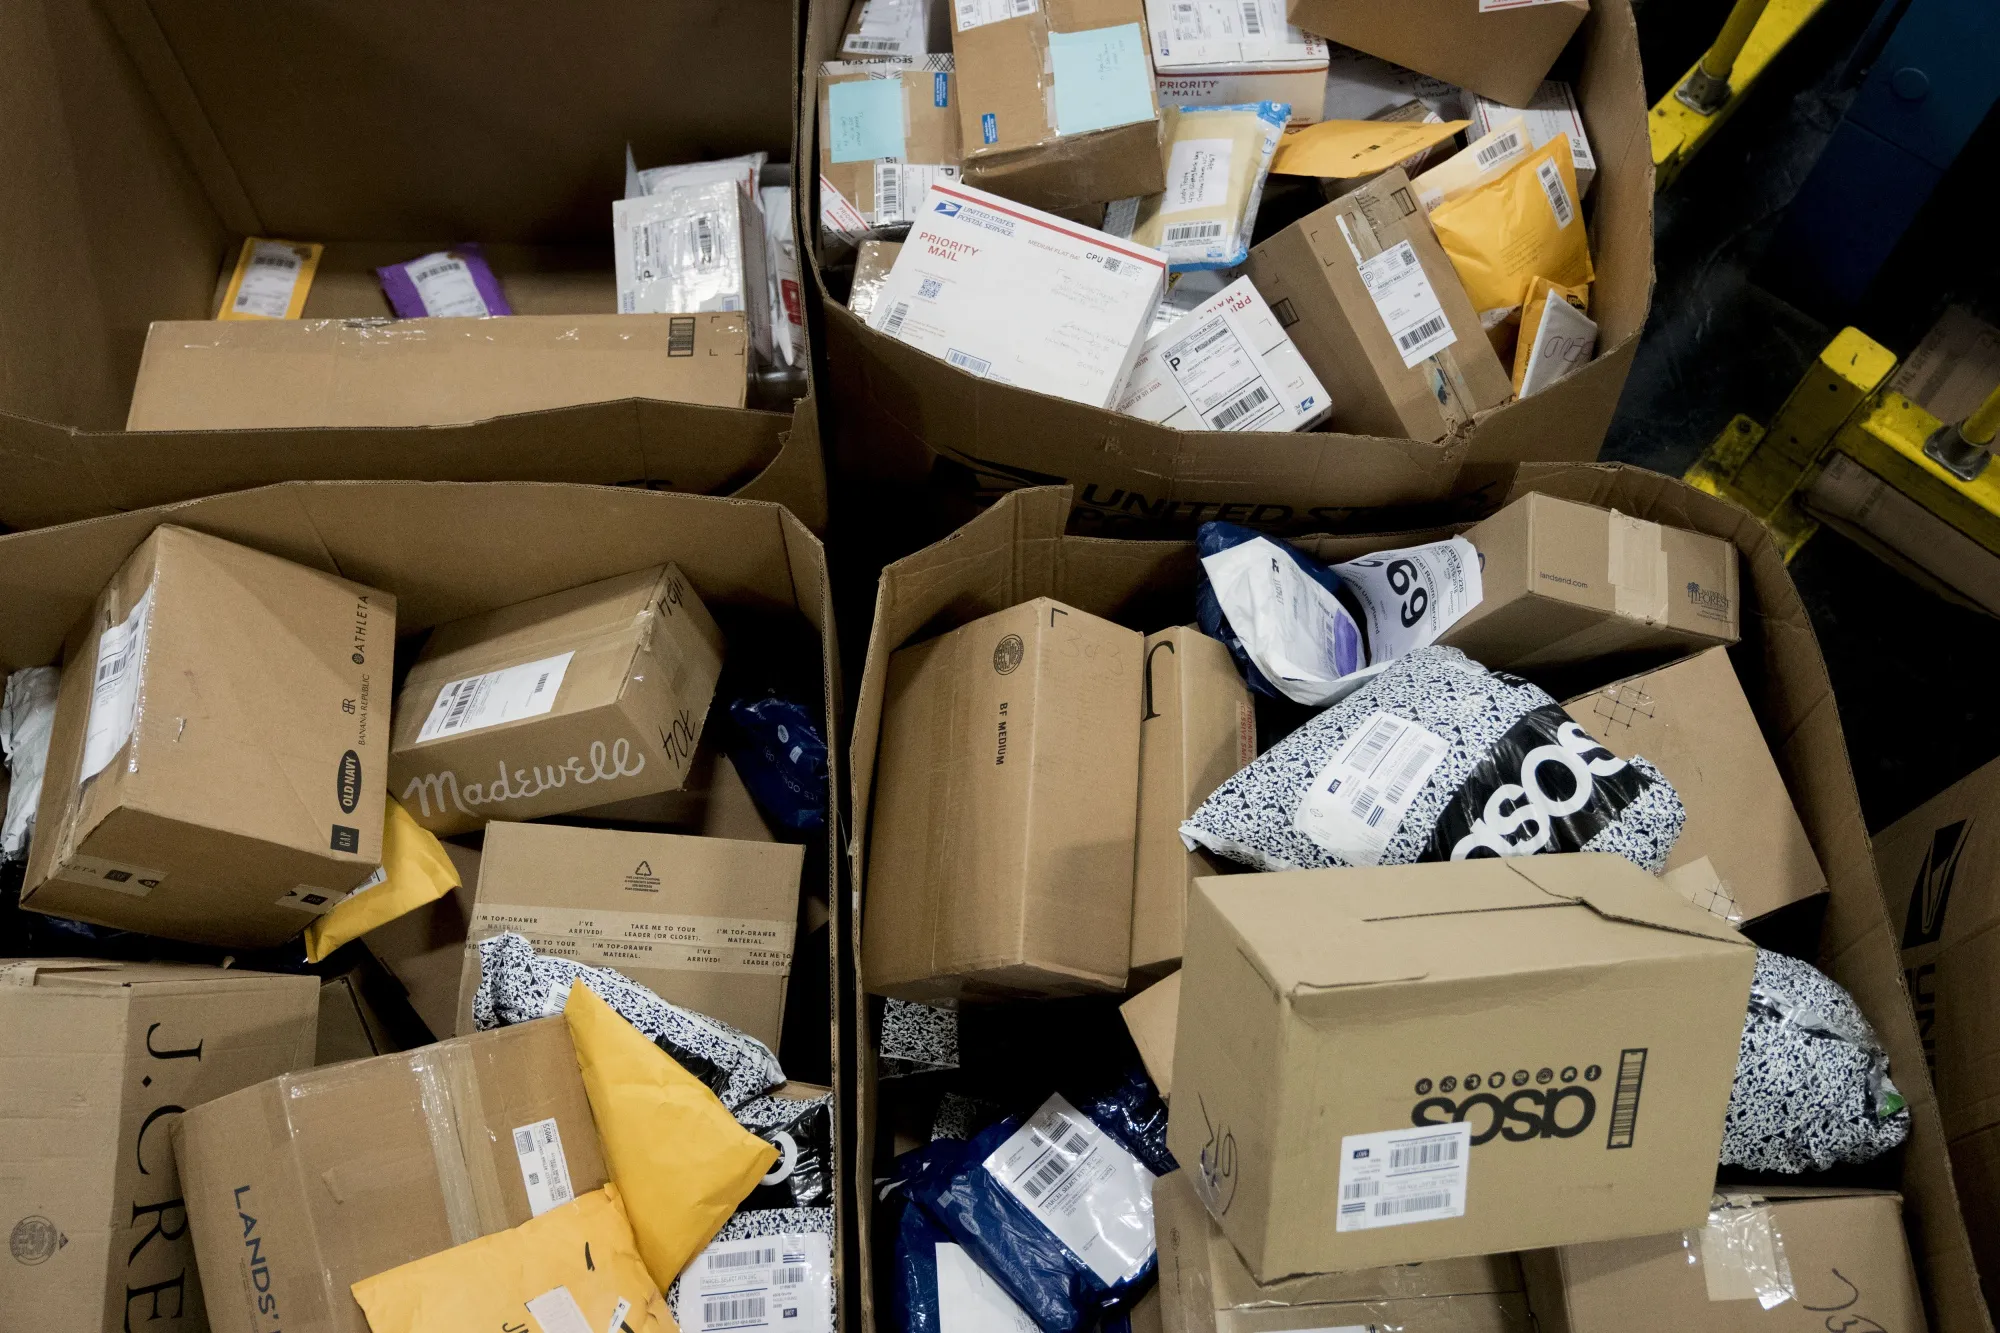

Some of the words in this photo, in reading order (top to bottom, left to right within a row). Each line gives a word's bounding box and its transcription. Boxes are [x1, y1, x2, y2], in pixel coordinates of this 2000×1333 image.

[1160, 80, 1216, 89] PRIORITY
[957, 214, 983, 228] POSTAL
[962, 206, 990, 221] UNITED
[990, 215, 1016, 228] STATES
[918, 231, 980, 257] PRIORITY
[927, 245, 958, 262] MAIL
[1028, 239, 1054, 252] MEDIUM
[1054, 248, 1070, 258] FLAT
[1085, 252, 1104, 264] CPU
[1362, 270, 1374, 288] P
[1168, 356, 1181, 372] P
[1080, 483, 1294, 525] UNITED
[1540, 572, 1588, 589] landsend.com
[1424, 569, 1436, 600] Return
[1430, 599, 1438, 632] Service
[1362, 590, 1372, 606] Unit
[1370, 606, 1380, 635] Placard
[354, 594, 369, 652] ATHLETA
[360, 674, 370, 710] REPUBLIC
[999, 702, 1008, 716] BF
[358, 710, 368, 746] BANANA
[996, 721, 1007, 766] MEDIUM
[346, 756, 357, 785] NAVY
[402, 738, 646, 818] Madewell
[343, 784, 354, 806] OLD
[339, 826, 352, 848] GAP
[490, 916, 538, 924] TOP-DRAWER
[568, 928, 604, 936] ARRIVED!
[730, 930, 776, 938] TOP-DRAWER
[602, 951, 642, 959] MATERIAL.
[606, 943, 653, 952] TOP-DRAWER
[1410, 1086, 1596, 1146] asos
[1044, 1192, 1064, 1210] PARCEL
[234, 1184, 281, 1322] LANDS'
